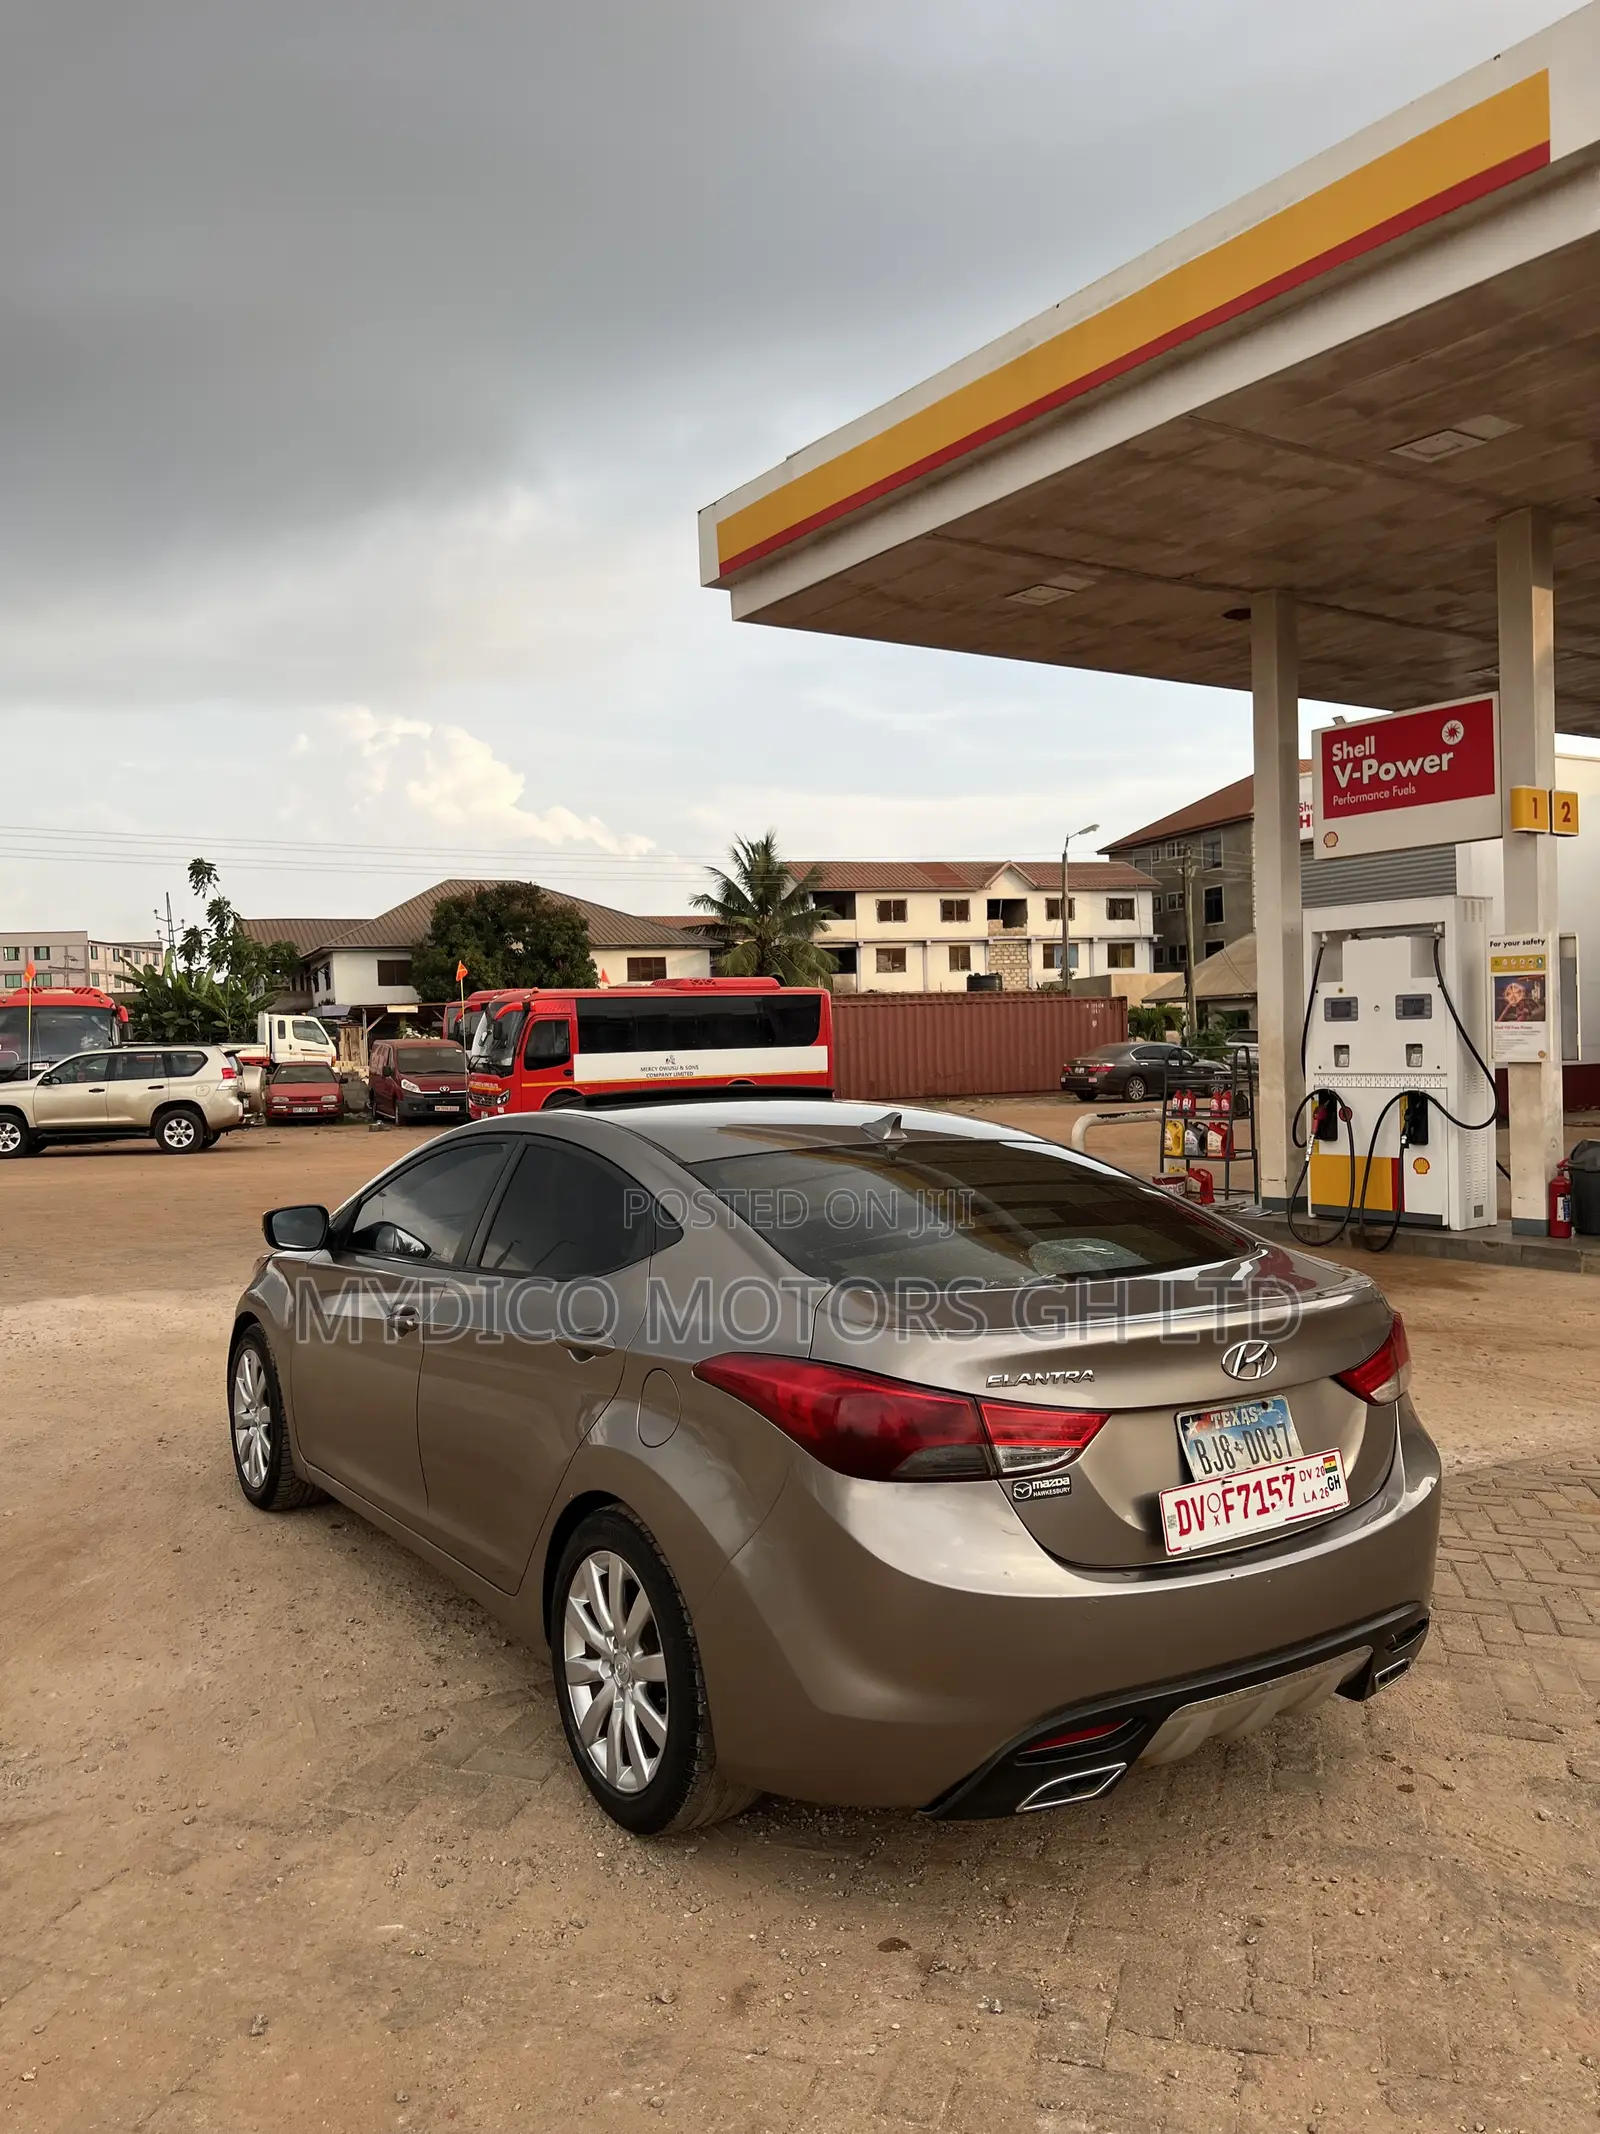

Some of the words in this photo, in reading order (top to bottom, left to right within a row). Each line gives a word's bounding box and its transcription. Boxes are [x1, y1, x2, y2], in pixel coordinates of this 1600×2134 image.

[1332, 735, 1375, 761] Shell
[1332, 751, 1454, 788] V-Power
[1333, 789, 1390, 806] Performance
[1392, 782, 1416, 797] Fuels
[1532, 797, 1538, 819] 1
[1561, 801, 1571, 822] 2
[1490, 940, 1501, 948] For
[1503, 940, 1521, 949] your
[1522, 937, 1546, 947] safety
[986, 1369, 1095, 1388] ELANTRA
[1210, 1406, 1259, 1430] TEXAS
[1300, 1469, 1313, 1482] DV
[1327, 1474, 1341, 1491] GH
[1033, 1487, 1071, 1497] HAWKESBURY
[1303, 1490, 1318, 1504] LA
[1174, 1495, 1204, 1536] DV
